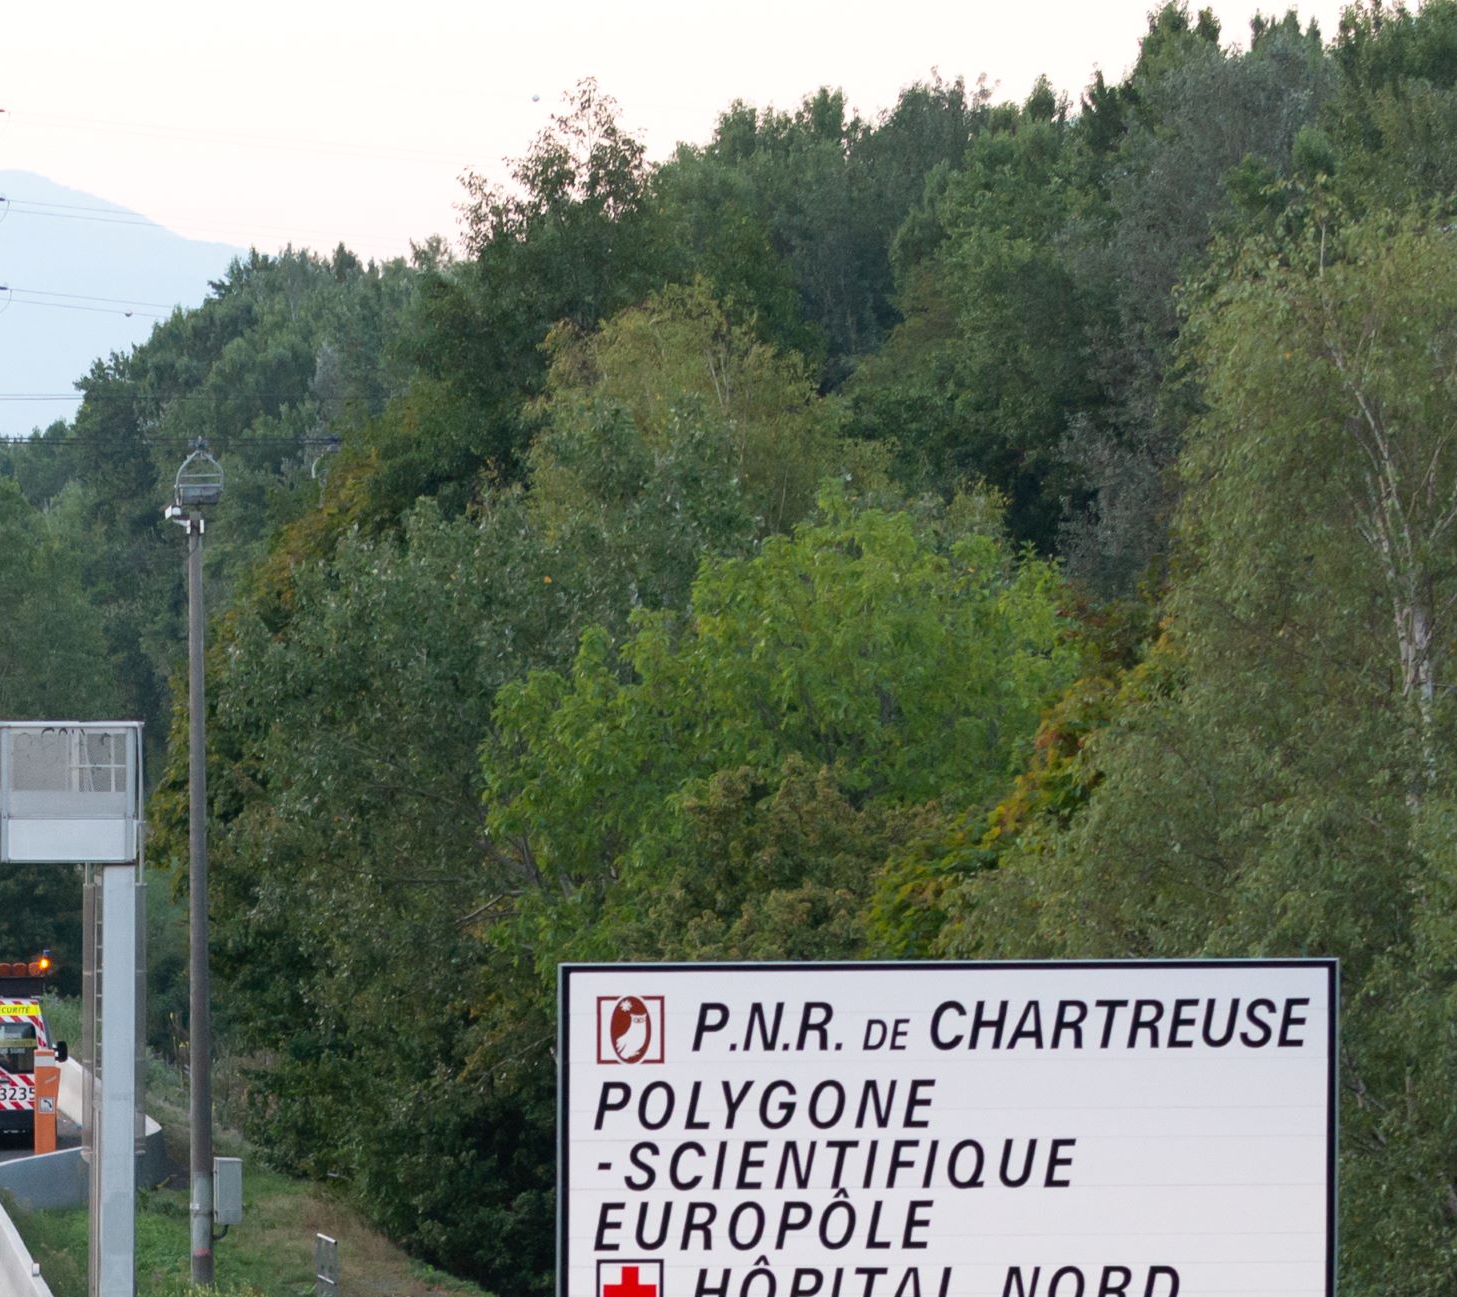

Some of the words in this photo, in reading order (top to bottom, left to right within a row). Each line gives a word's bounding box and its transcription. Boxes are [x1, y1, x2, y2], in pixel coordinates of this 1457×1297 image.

[692, 1003, 843, 1052] P.N.R.
[862, 1020, 908, 1050] DE
[930, 997, 1309, 1050] CHARTREUSE
[594, 1079, 936, 1130] POLYGONE
[596, 1139, 1078, 1192] -SCIENTIFIQUE
[594, 1189, 935, 1252] EUROPÔLE
